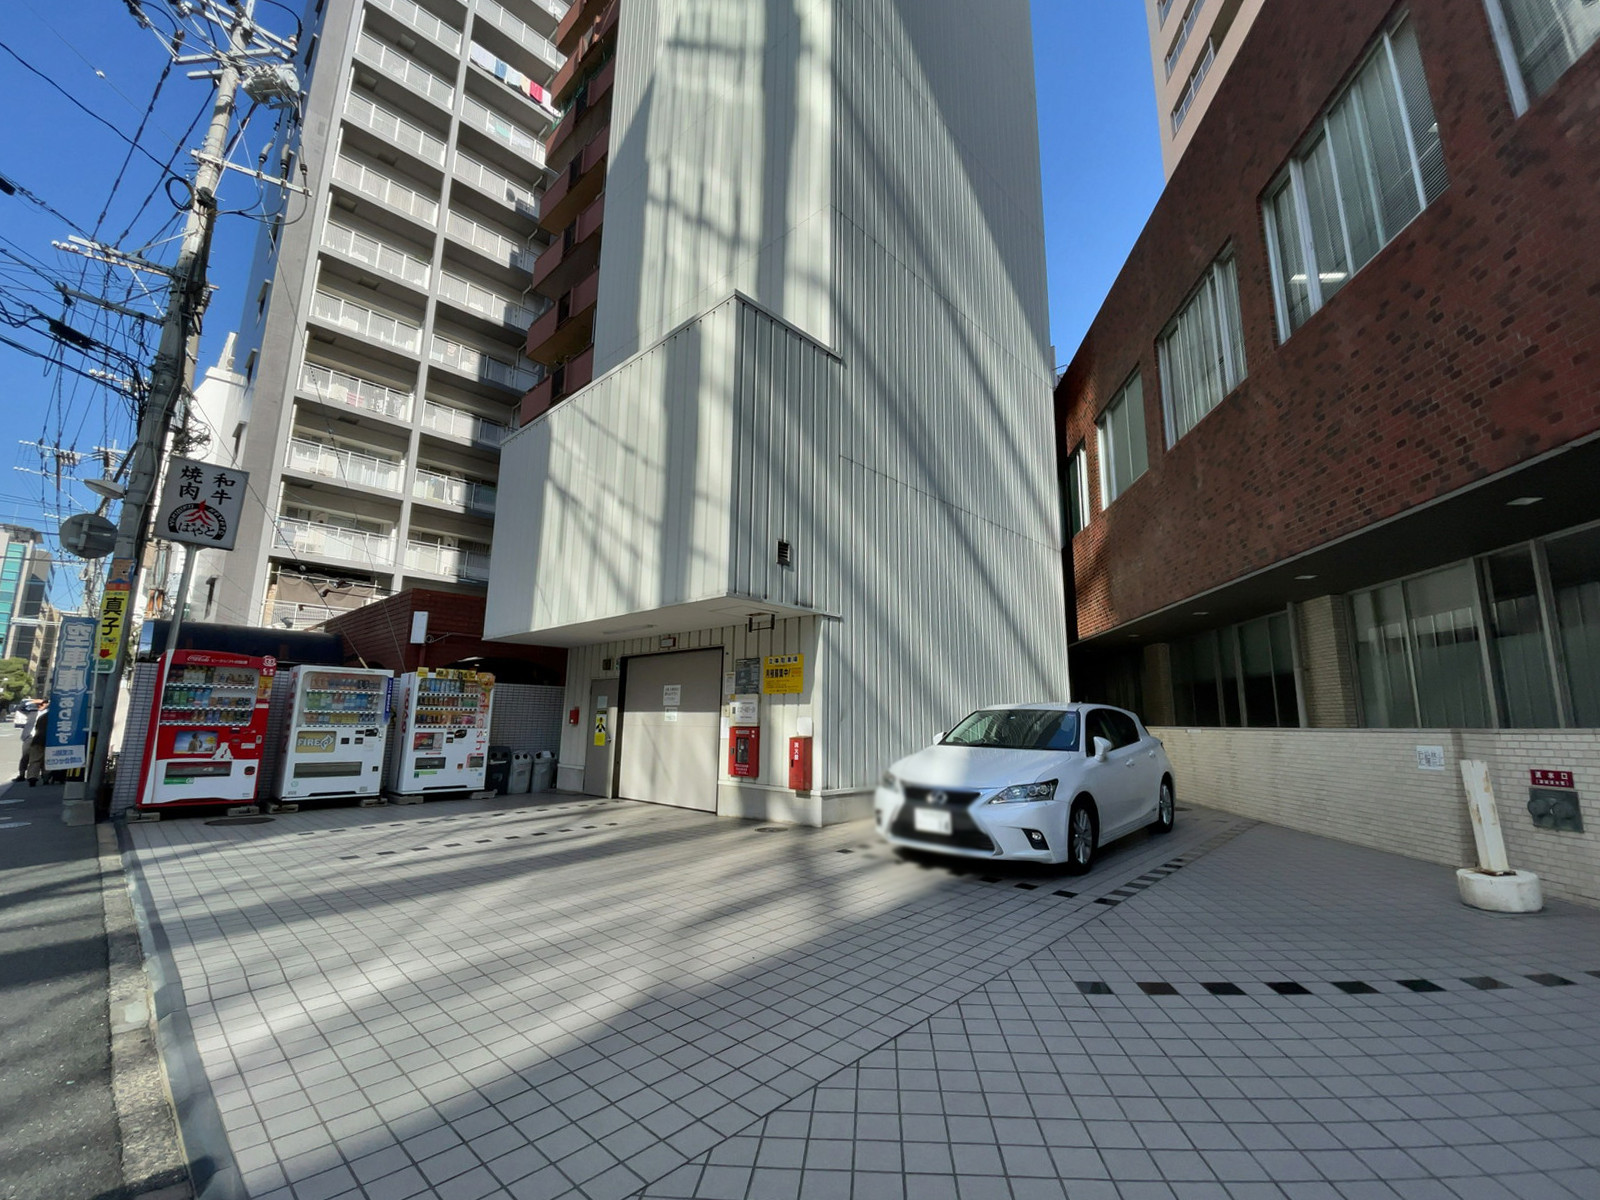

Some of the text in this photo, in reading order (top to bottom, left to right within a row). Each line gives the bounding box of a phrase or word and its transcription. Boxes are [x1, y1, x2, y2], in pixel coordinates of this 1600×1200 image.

[179, 465, 204, 501] 焼肉
[210, 472, 237, 506] 和牛
[177, 522, 216, 537] はやと
[101, 596, 124, 636] 真子
[297, 737, 321, 747] FIRE
